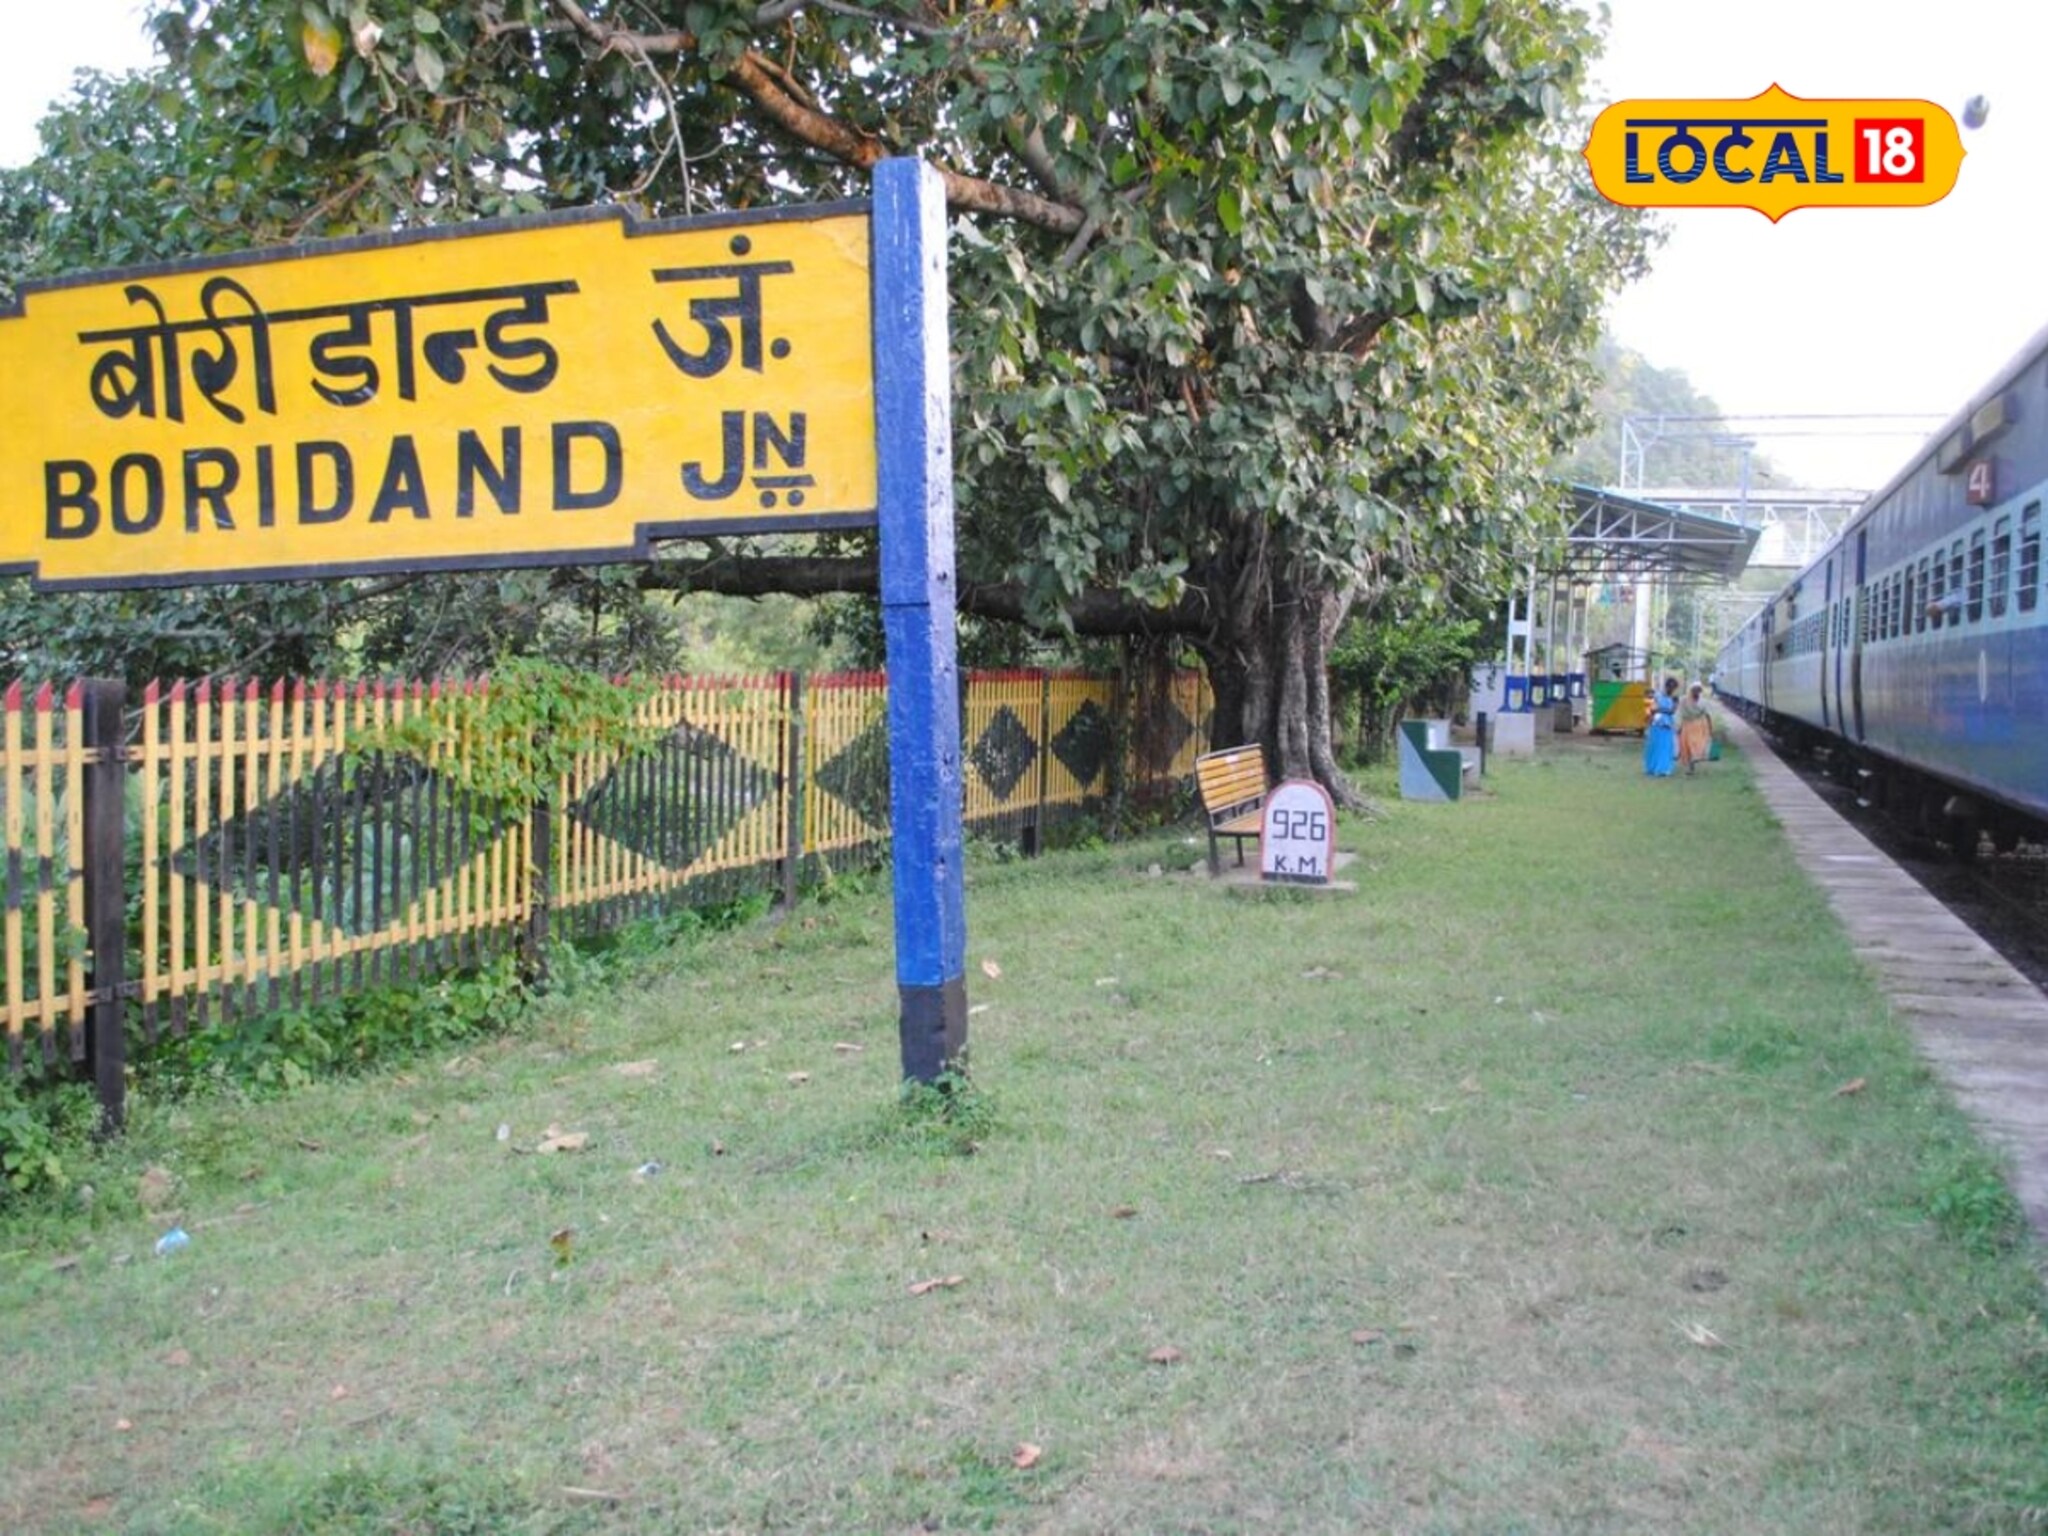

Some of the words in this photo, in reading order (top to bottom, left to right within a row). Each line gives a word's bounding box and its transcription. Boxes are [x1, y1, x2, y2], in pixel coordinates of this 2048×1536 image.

[78, 276, 580, 423] बोरीडान्ड
[44, 420, 624, 539] BORIDAND
[1968, 463, 1991, 498] 4
[1272, 809, 1326, 841] 926
